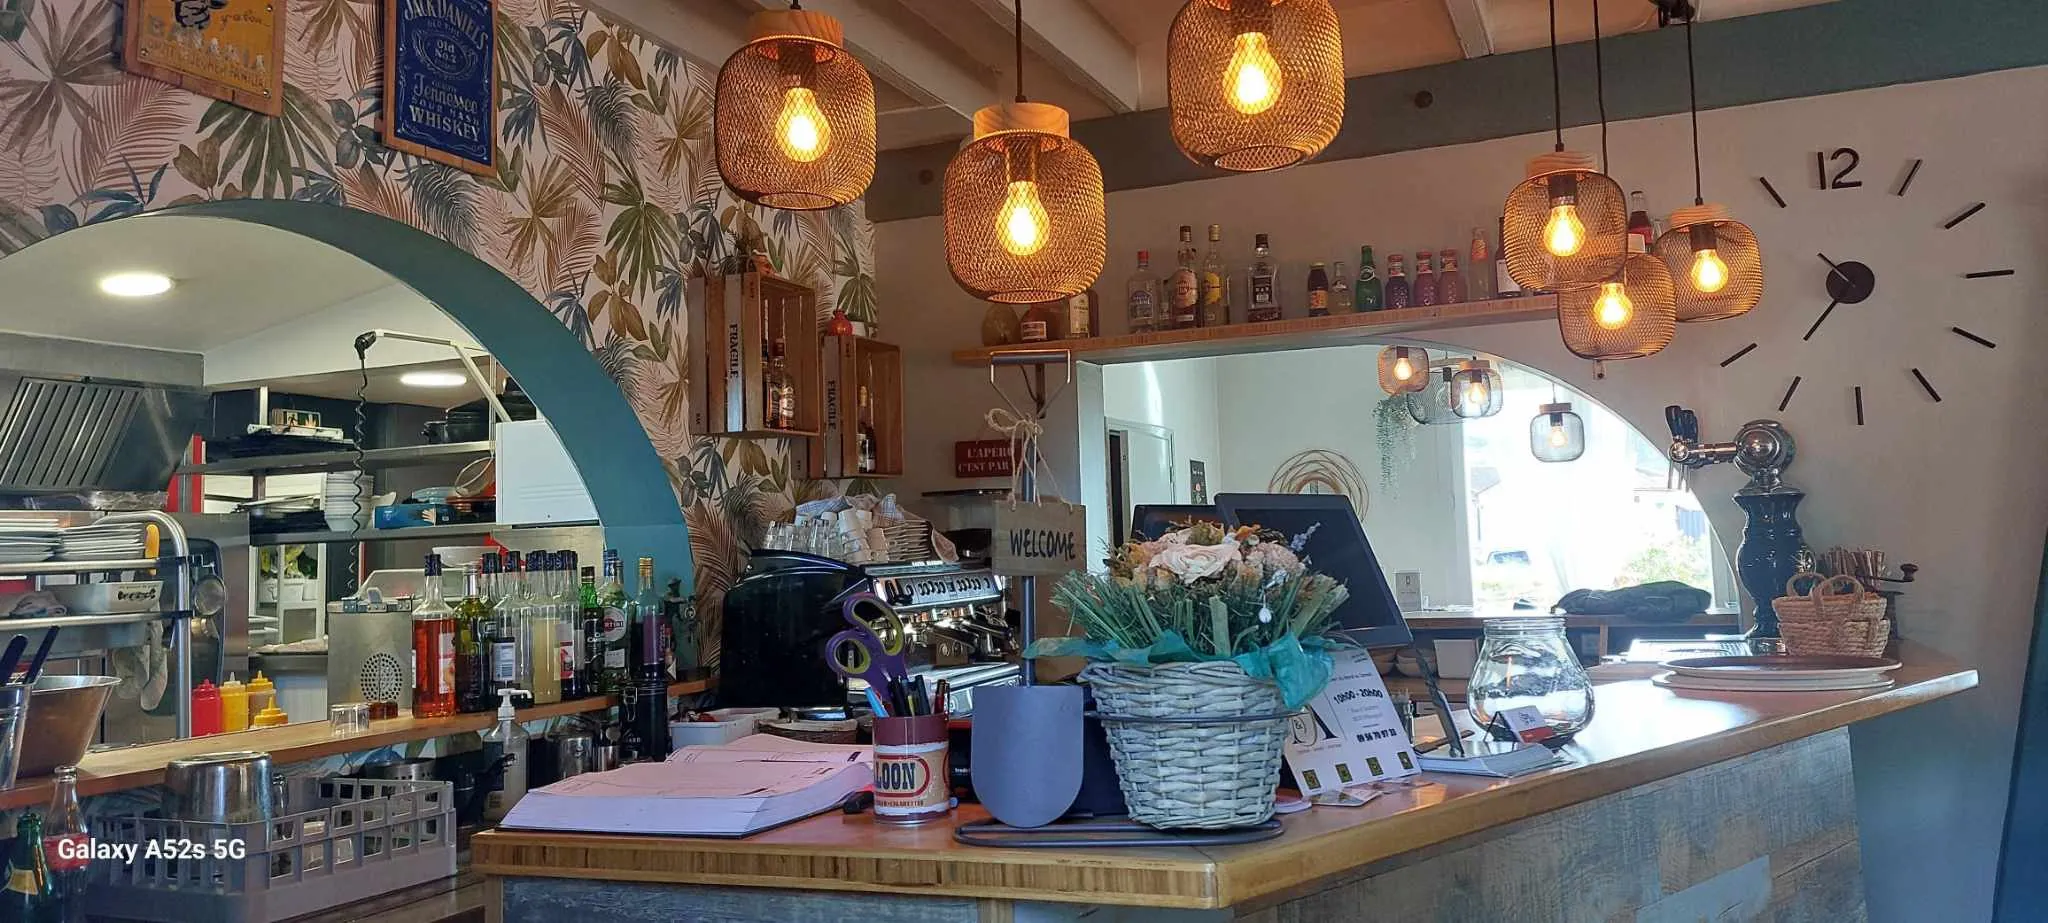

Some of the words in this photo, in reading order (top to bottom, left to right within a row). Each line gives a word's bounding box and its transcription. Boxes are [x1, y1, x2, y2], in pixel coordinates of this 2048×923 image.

[404, 0, 437, 20] JACK
[437, 0, 488, 50] DANIEL'S
[414, 73, 478, 114] Tennessee
[409, 105, 480, 142] WHISKEY
[1816, 147, 1863, 190] 12
[729, 323, 739, 379] FRAGILE
[827, 380, 837, 430] FRAGILE
[988, 460, 1009, 472] PAR
[1010, 528, 1076, 561] WELCOME
[875, 762, 916, 790] LOON
